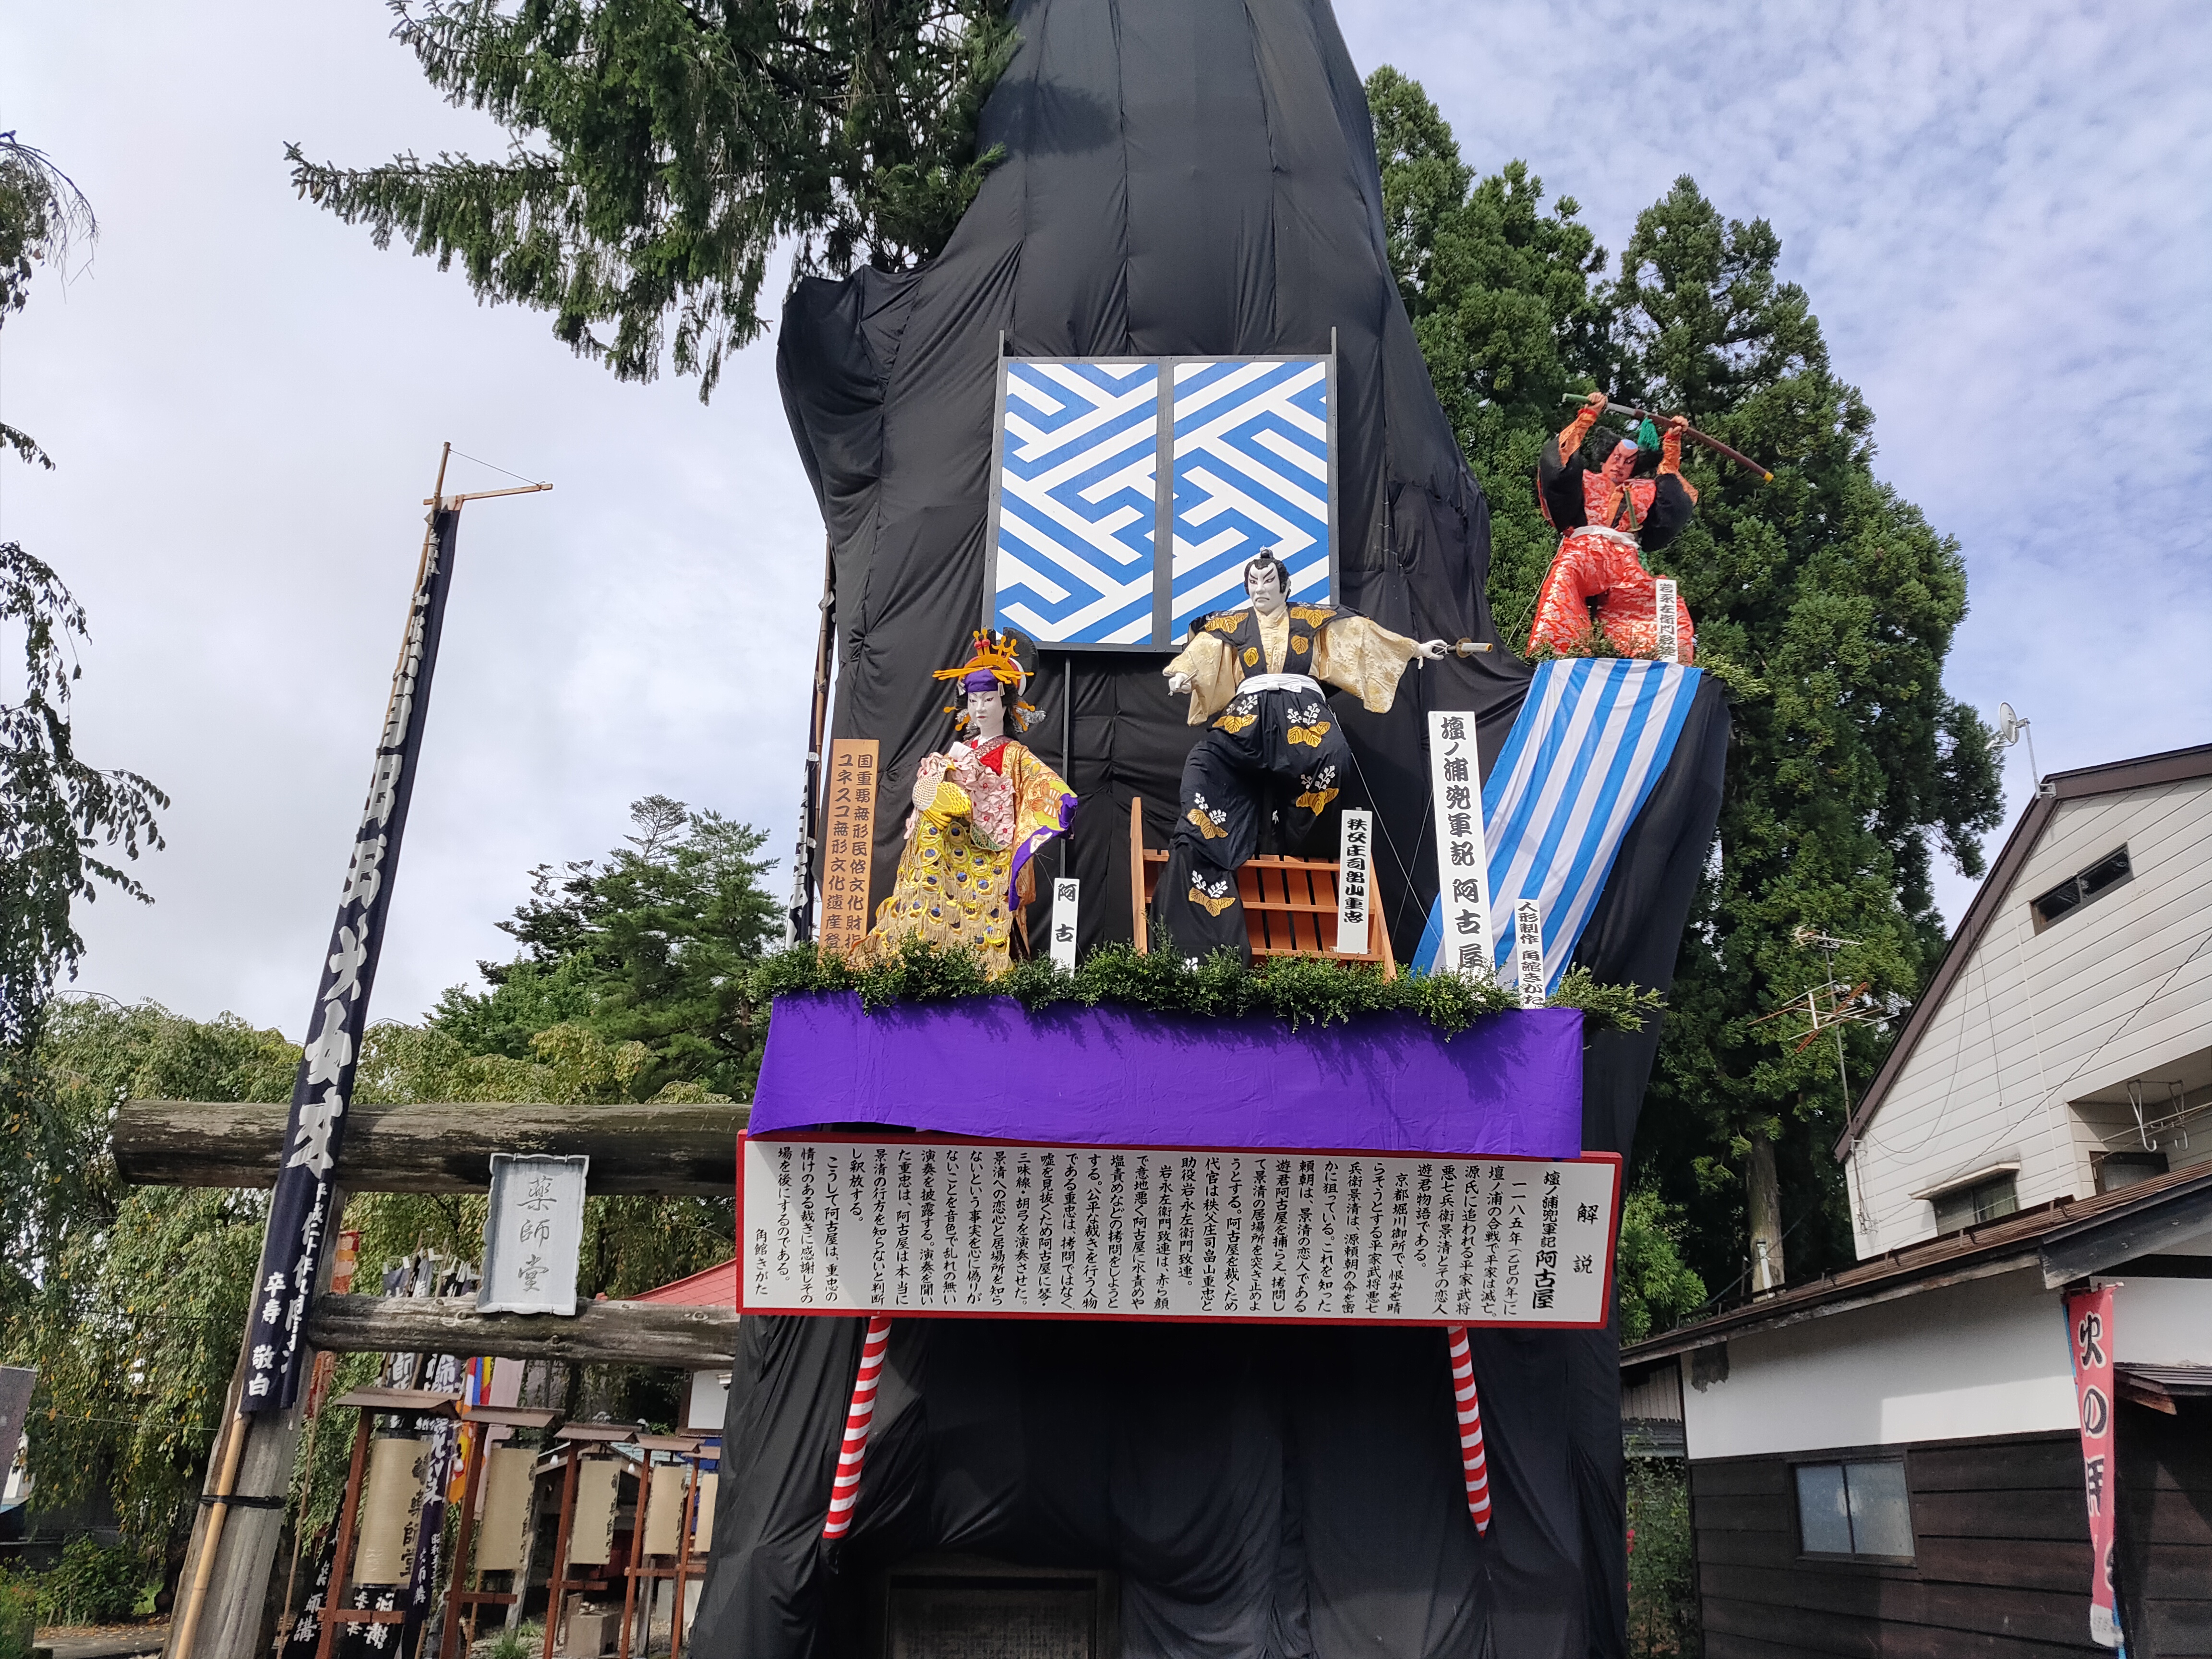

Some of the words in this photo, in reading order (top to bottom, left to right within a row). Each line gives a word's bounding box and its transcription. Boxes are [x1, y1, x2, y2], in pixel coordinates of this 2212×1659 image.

[845, 754, 873, 967] 国重要無形民俗文化財指
[1055, 883, 1077, 974] 阿古
[1517, 901, 1540, 945] 人形制作
[1521, 950, 1545, 1005] 角館きがた
[777, 1146, 793, 1281] 場を後にするのである。
[799, 1147, 816, 1305] 情けのある裁きに感謝しその
[824, 1156, 841, 1302] こうして阿古屋は、重忠の
[848, 1147, 866, 1222] し釈放する。
[870, 1148, 888, 1306] 景清の行方を知らないと判断
[894, 1148, 912, 1306] た重忠は、阿古屋は本当に
[919, 1148, 937, 1306] 演奏を披露する。演奏を聞い
[942, 1149, 960, 1305] ないことを音色で乱れの無い
[966, 1150, 984, 1305] ないという事実を心に偽りが
[989, 1151, 1007, 1306] 景清への恋心と居場所を知ら
[1014, 1152, 1032, 1305] 三味線・胡弓を演奏させた。
[1036, 1152, 1056, 1307] 嘘を見抜くため阿古屋に琴・
[1060, 1153, 1079, 1310] である重忠は、拷問ではなく、
[1082, 1153, 1103, 1310] する。公平な裁きを行う人物
[1107, 1154, 1126, 1309] 塩責めなどの拷問をしようと
[1130, 1155, 1150, 1310] で意地悪く阿古屋に水責めや
[1153, 1164, 1174, 1310] 岩永左衛門致連は、赤ら顔
[1178, 1155, 1197, 1286] 助役岩永左衛門致連。
[1223, 1157, 1243, 1312] うとする。阿古屋を裁くため
[1248, 1158, 1268, 1311] て景清の居場所を突き止めよ
[1271, 1158, 1292, 1312] 遊君阿古屋を捕らえ、拷問し
[1294, 1159, 1315, 1313] 頼朝は、景清の恋人である
[1318, 1160, 1339, 1312] かに狙っている。これを知った
[1365, 1162, 1385, 1313] らそうとする平家武将悪七
[1386, 1172, 1409, 1315] 京都堀川御所で、恨みを晴
[1413, 1162, 1433, 1268] 遊君物語である。
[1431, 1164, 1457, 1315] 悪七兵衛景清とその恋人
[1455, 1165, 1480, 1316] 源氏に追われる平家武将
[1480, 1164, 1505, 1318] 壇ノ浦の合戦で平家は滅亡。
[1573, 1202, 1599, 1274] 解説
[262, 1272, 287, 1325] 卒寿
[754, 1228, 769, 1295] 角館きがた
[248, 1344, 276, 1397] 敬白
[2080, 1314, 2114, 1589] 火の用
